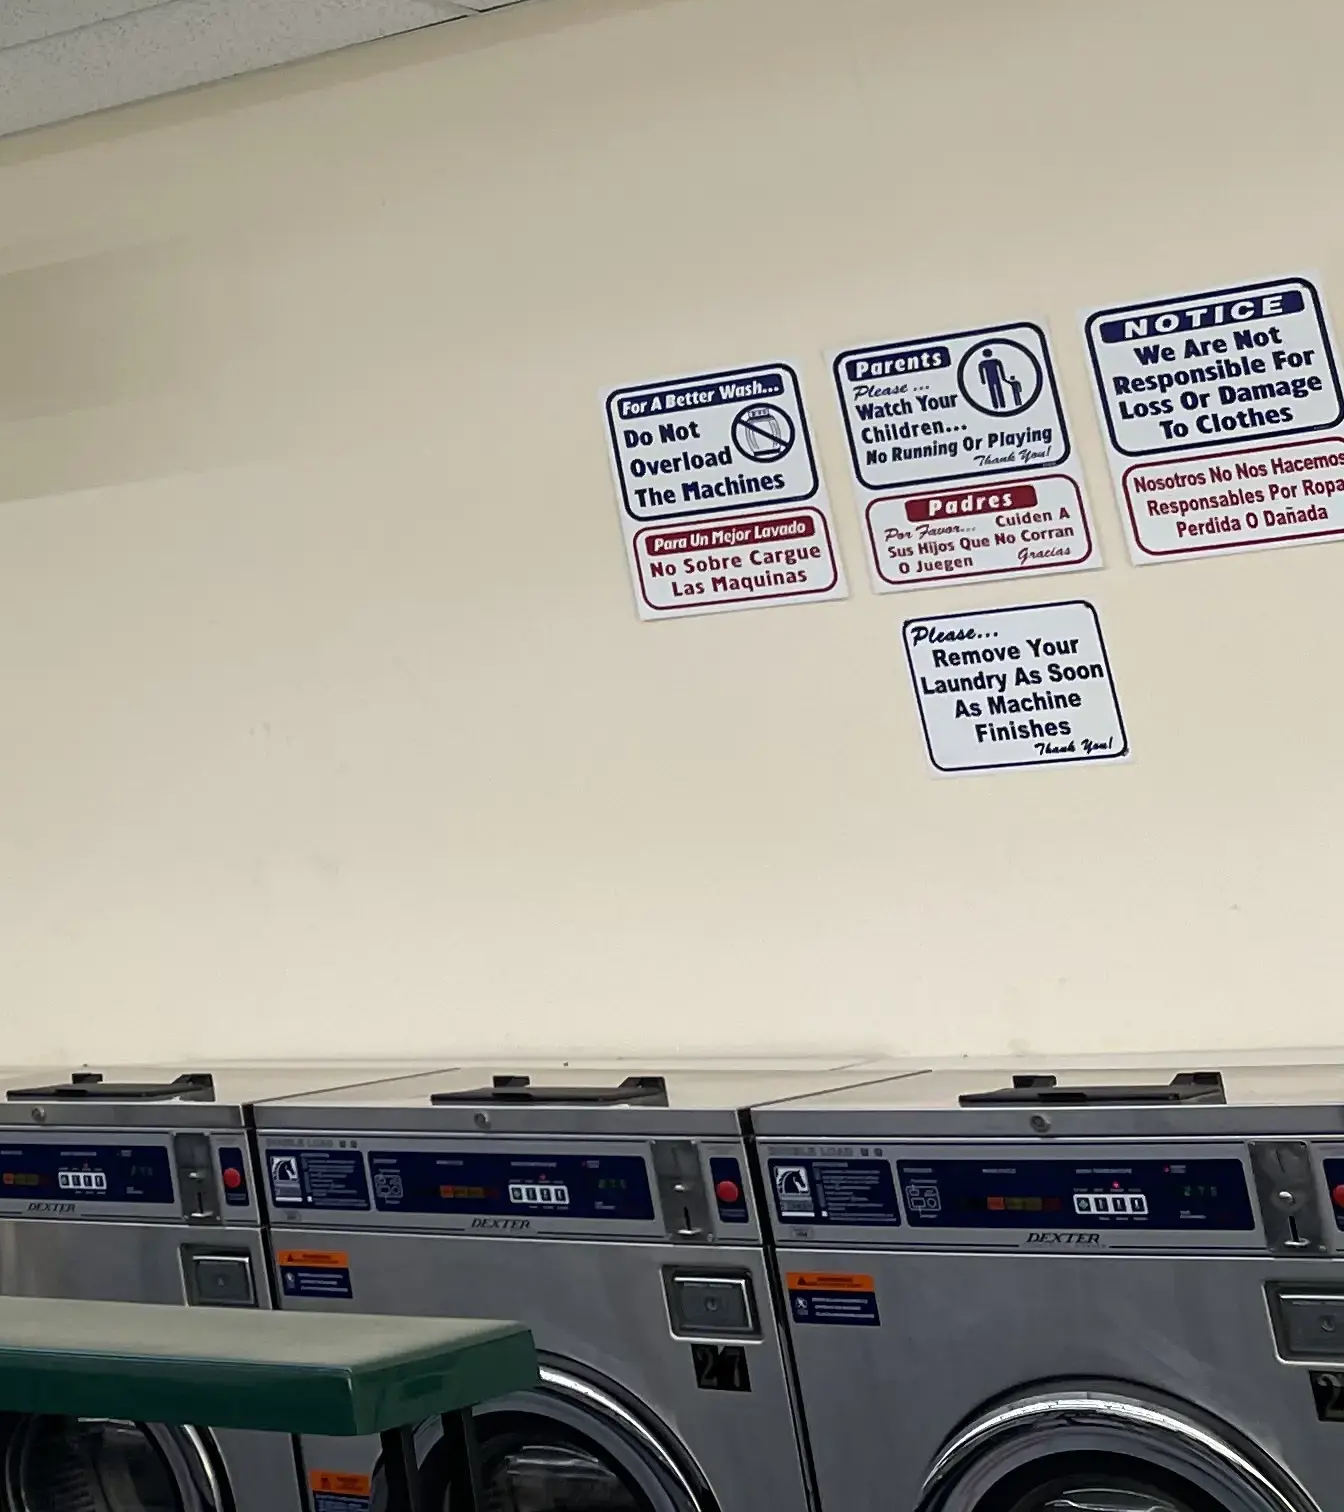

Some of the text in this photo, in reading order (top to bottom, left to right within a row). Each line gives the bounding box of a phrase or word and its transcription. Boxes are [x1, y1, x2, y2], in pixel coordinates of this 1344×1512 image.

[1125, 296, 1283, 338] NOTICE
[1134, 327, 1282, 366] We Are Not
[856, 351, 941, 378] Parents
[1113, 349, 1315, 395] Responsible For
[623, 381, 779, 416] For A Better Wash...
[855, 394, 957, 420] Watch Your
[1119, 375, 1322, 419] Loss Or Damage
[624, 422, 700, 448] Do Not
[862, 420, 967, 445] Children...
[1159, 407, 1293, 439] To Clothes
[631, 446, 732, 477] Overload
[866, 428, 1052, 465] No Running Or Playing
[974, 446, 1051, 467] Thank You!
[1133, 452, 1344, 493] Nosotros No Nos Hacemos
[635, 474, 785, 507] The Machines
[928, 493, 1012, 516] Padres
[1147, 478, 1344, 516] Responsables Por Ropa
[654, 521, 805, 552] Para Un Mejor Lavado
[884, 528, 912, 542] Por
[995, 511, 1052, 527] Cuiden
[1059, 507, 1070, 520] A
[1176, 505, 1328, 538] Perdida O Dañada
[888, 528, 1074, 558] Sus Hijos Que No Corran
[1017, 546, 1070, 565] Gracias
[650, 546, 821, 577] No Sobre Cargue
[899, 556, 973, 574] O Juegen
[672, 569, 807, 597] Las Maquinas
[911, 626, 998, 646] Please...
[932, 638, 1079, 667] Remove Your
[921, 663, 1104, 695] Laundry As Soon
[955, 691, 1081, 718] As Machine
[975, 719, 1071, 742] Finishes
[1035, 736, 1113, 755] Thank You!
[472, 1218, 530, 1229] DEXTER
[1026, 1233, 1100, 1244] DEXTER
[697, 1348, 740, 1387] 27
